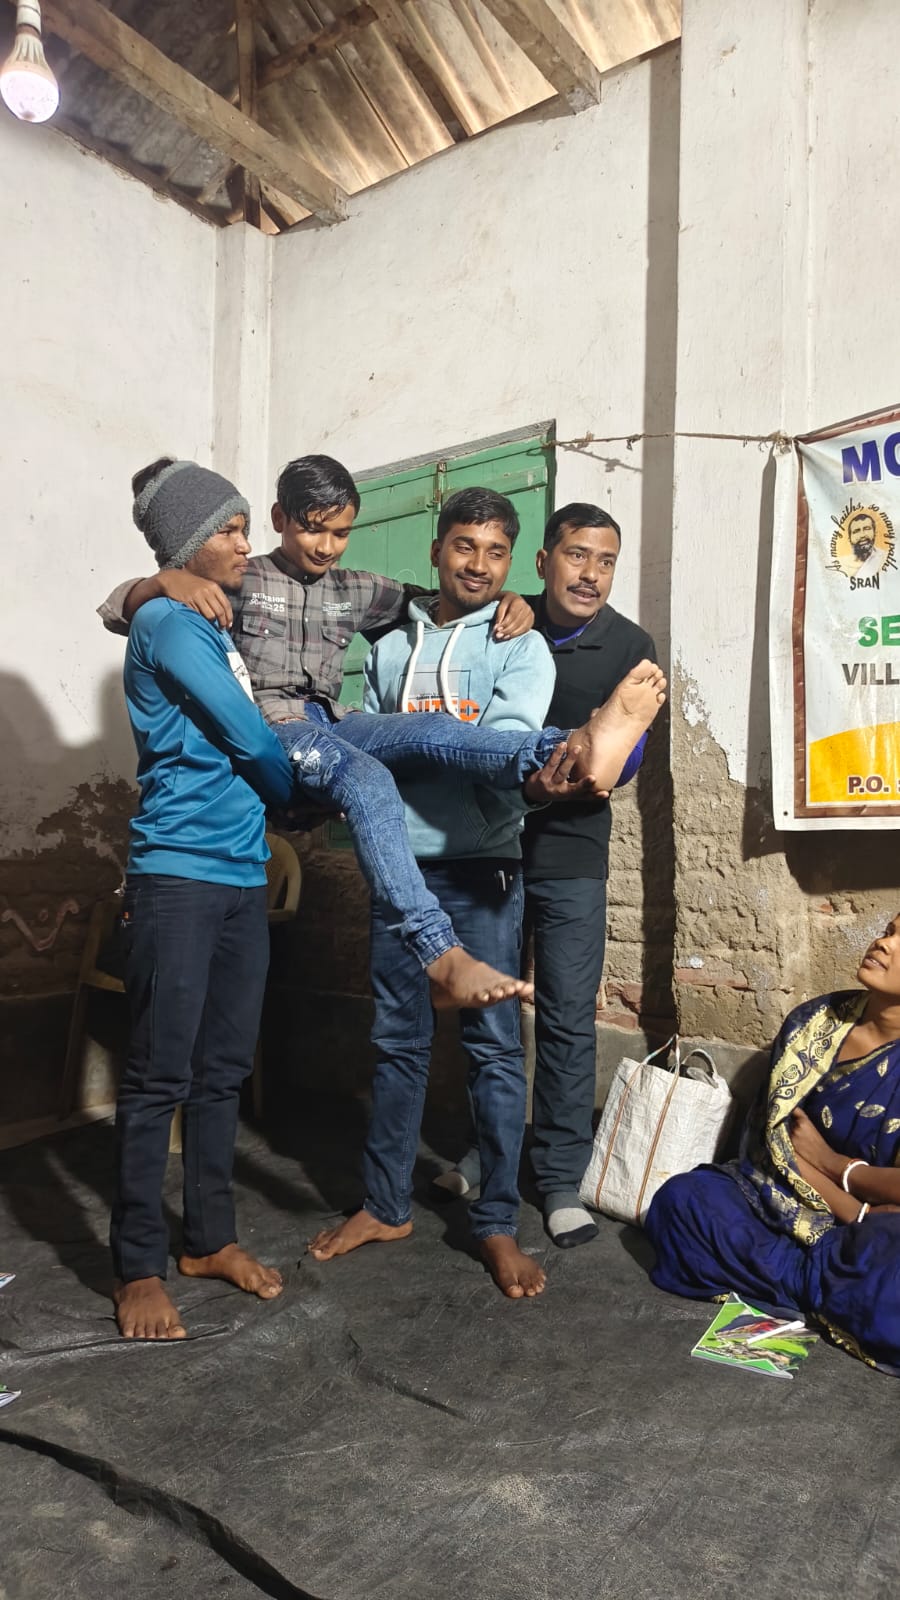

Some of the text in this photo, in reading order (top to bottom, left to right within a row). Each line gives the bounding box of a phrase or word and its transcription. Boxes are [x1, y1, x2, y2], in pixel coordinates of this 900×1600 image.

[868, 503, 879, 512] so
[880, 511, 895, 539] many
[830, 530, 843, 557] many
[882, 541, 898, 572] paths
[849, 572, 880, 591] SRAN
[273, 604, 285, 612] 25
[858, 615, 900, 647] SE
